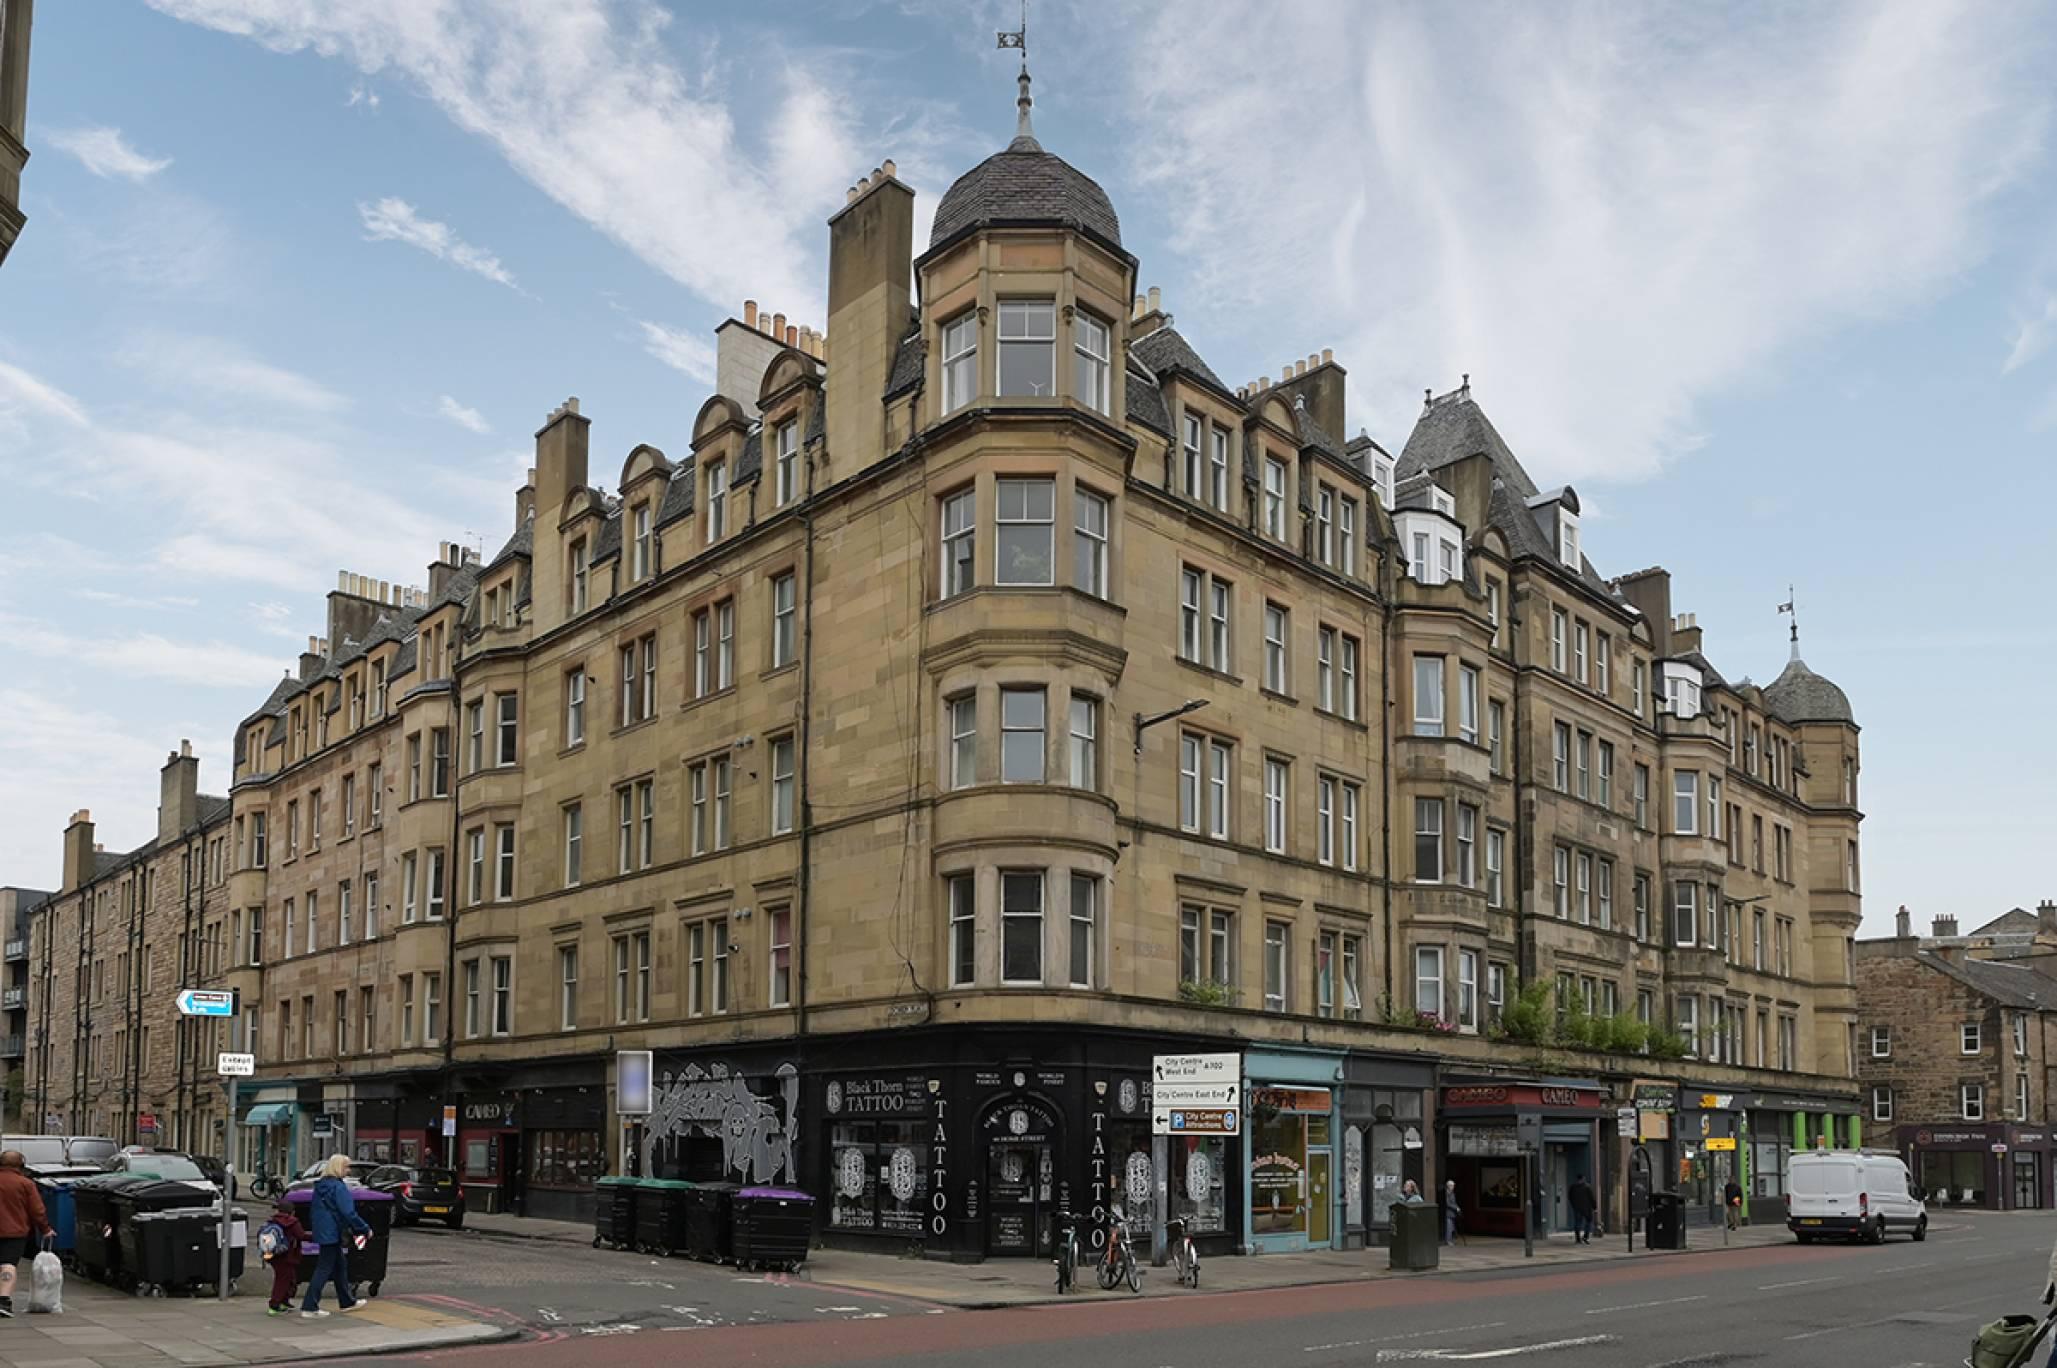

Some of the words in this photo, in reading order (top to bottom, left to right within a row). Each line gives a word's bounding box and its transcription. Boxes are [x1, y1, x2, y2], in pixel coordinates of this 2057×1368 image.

[846, 1079, 870, 1094] Black
[872, 1079, 904, 1093] Thorn
[1157, 1091, 1170, 1099] City
[1172, 1090, 1194, 1098] Centre
[1195, 1090, 1210, 1098] East
[1212, 1090, 1225, 1098] End
[1448, 1087, 1507, 1102] CAMEO
[846, 1094, 904, 1112] TATTOO
[1542, 1088, 1579, 1105] CAMEO
[465, 1103, 501, 1120] CAMEO
[1186, 1112, 1199, 1121] City
[1200, 1112, 1222, 1120] Centre
[1186, 1121, 1222, 1129] Attractions
[932, 1099, 947, 1236] TATTOO
[1091, 1112, 1105, 1249] TATTOO
